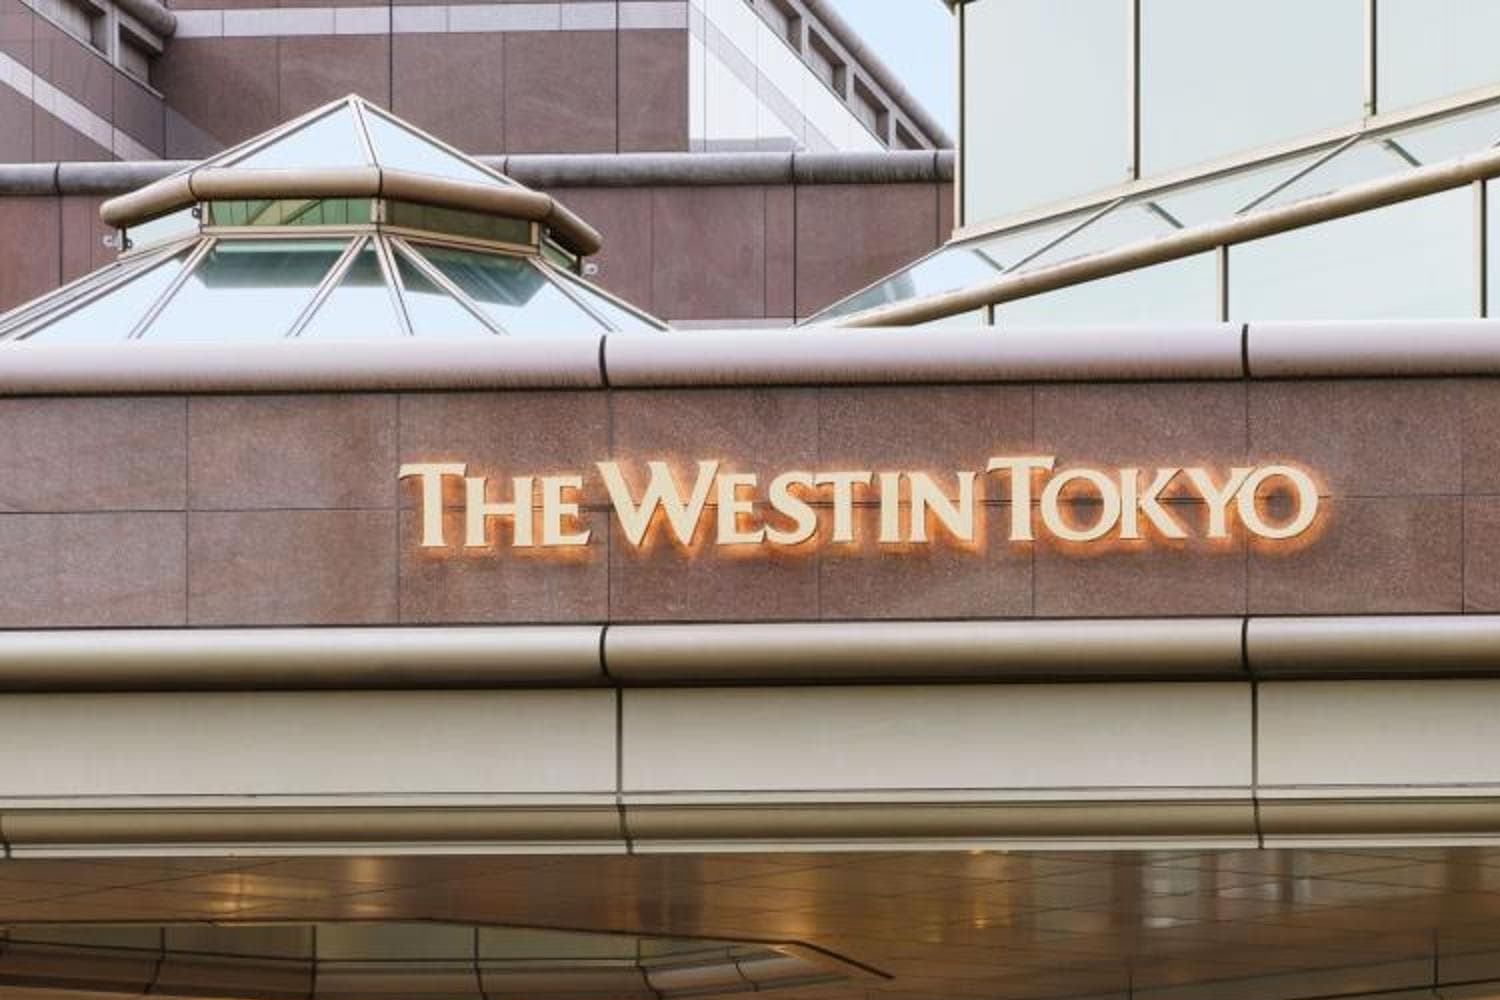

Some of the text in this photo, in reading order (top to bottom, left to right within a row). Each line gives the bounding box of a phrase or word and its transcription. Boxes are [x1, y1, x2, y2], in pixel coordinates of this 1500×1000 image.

[397, 456, 1319, 547] THE WESTIN TOKYO
